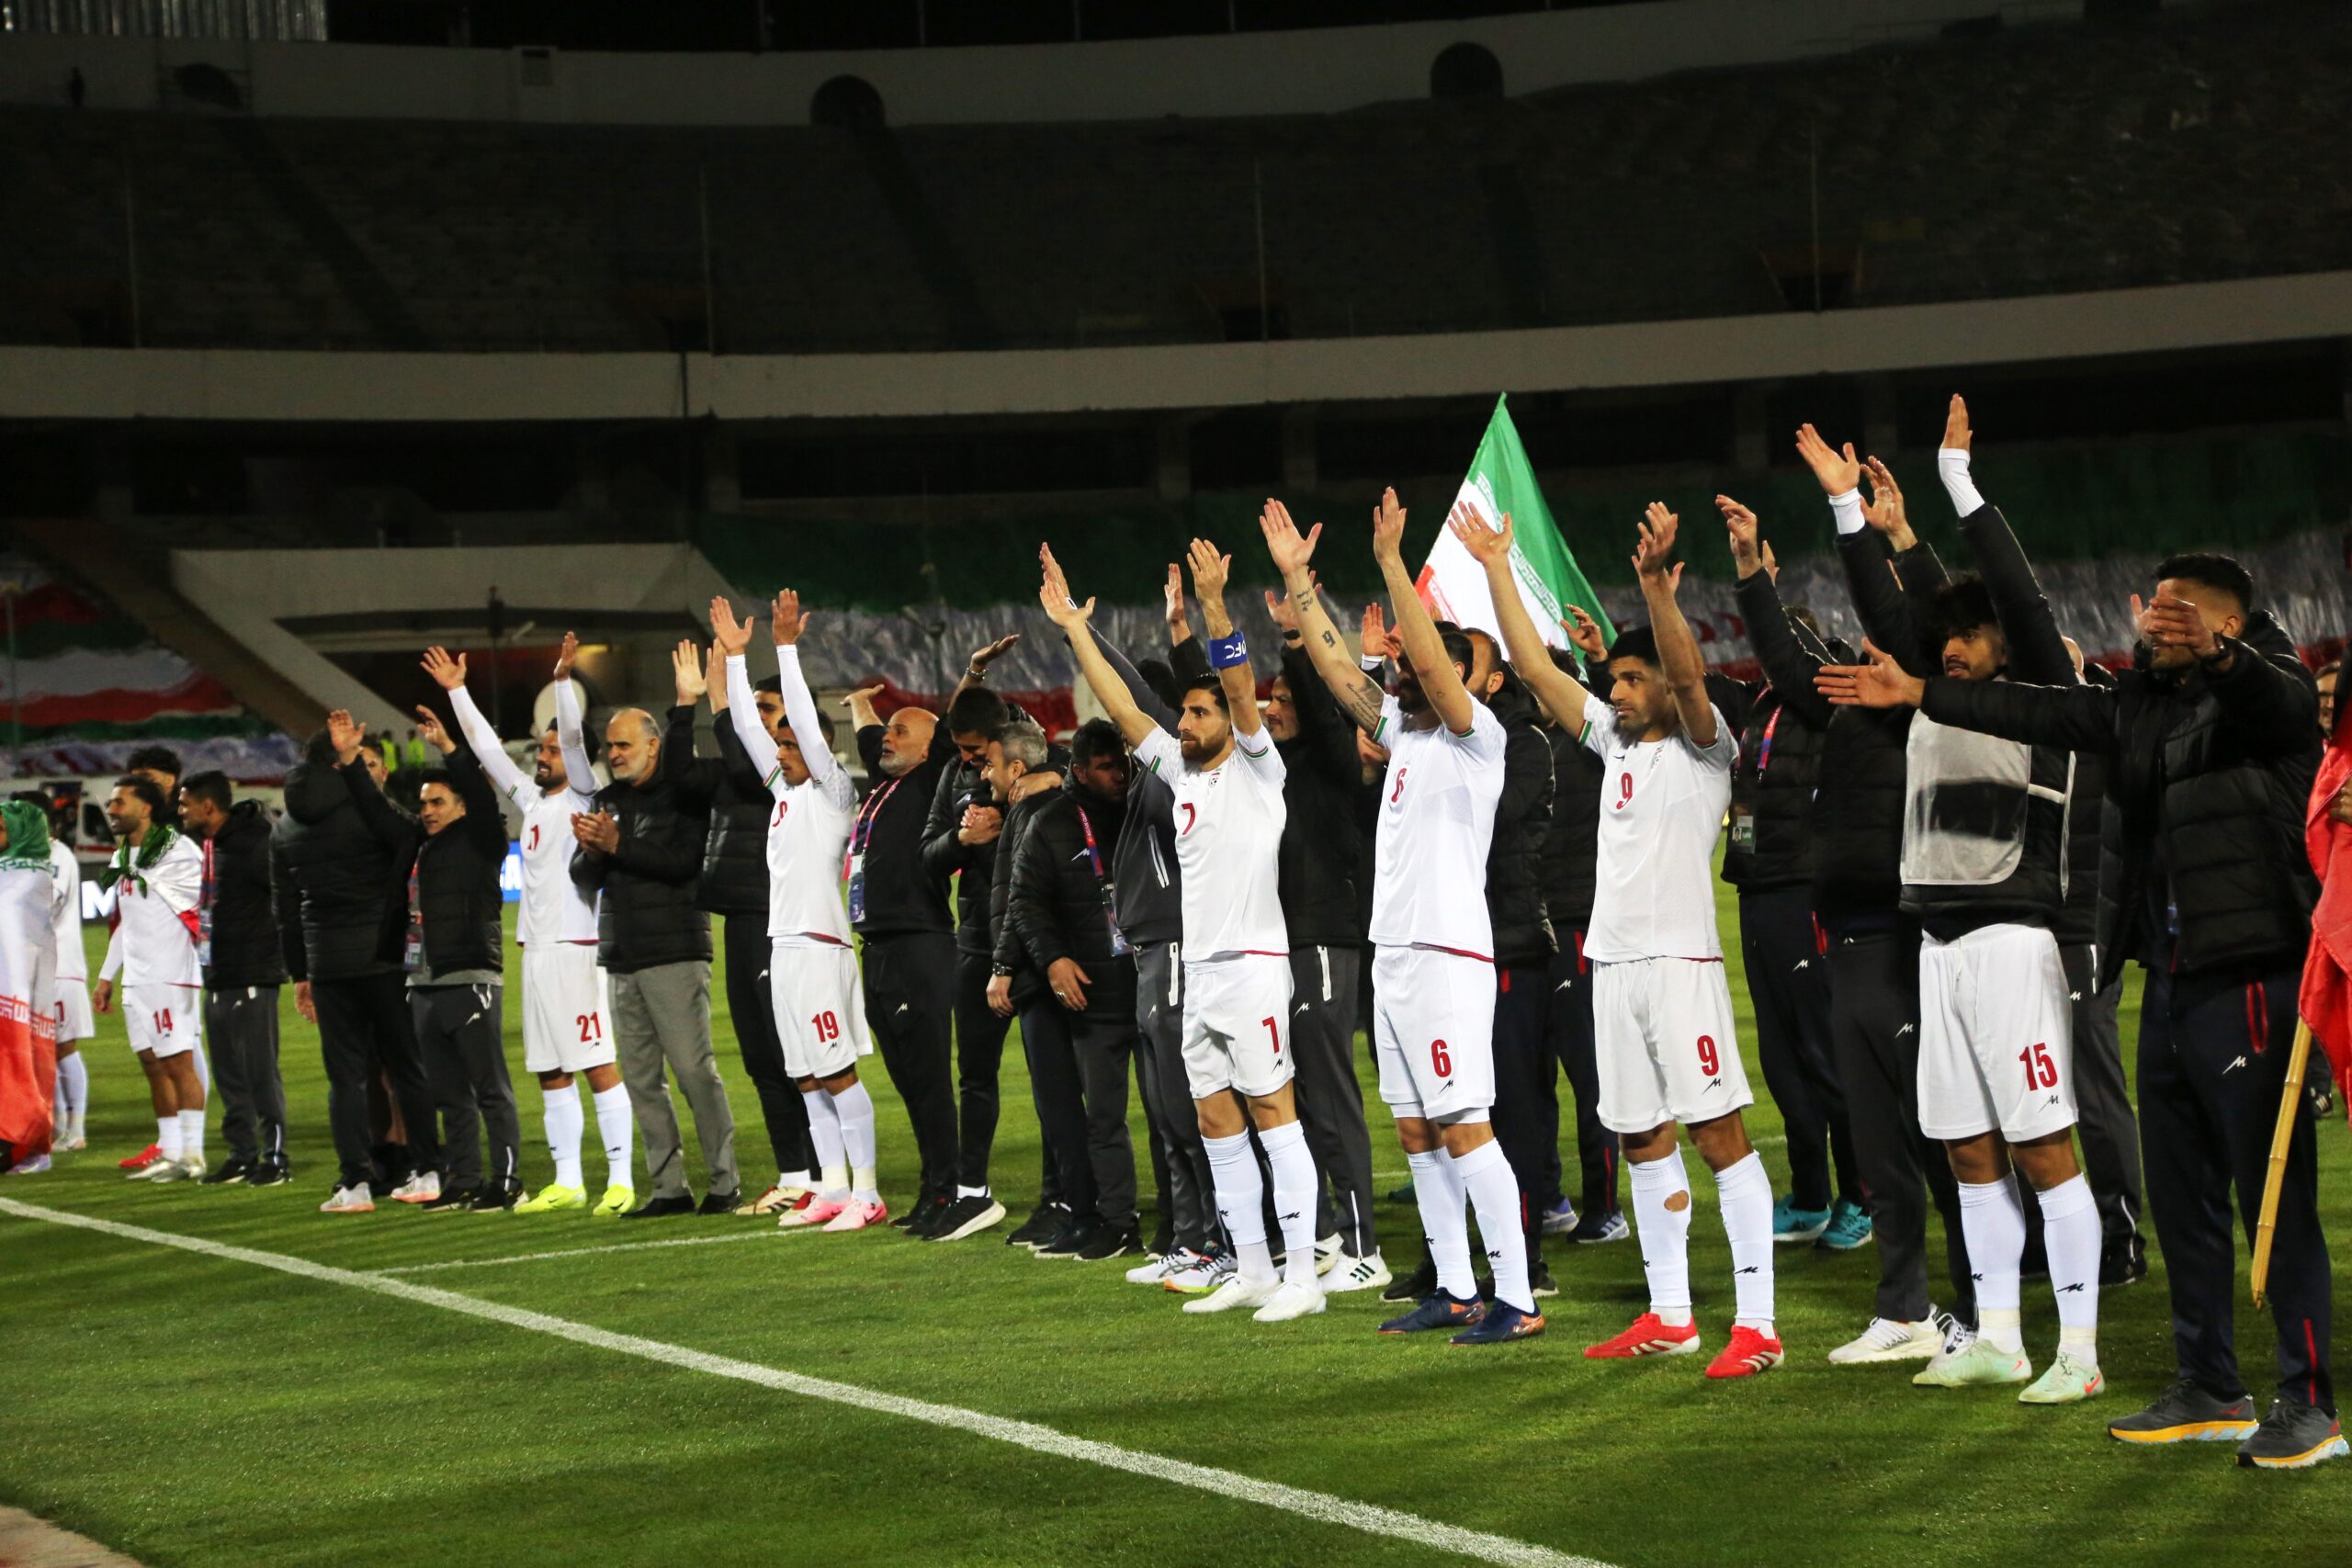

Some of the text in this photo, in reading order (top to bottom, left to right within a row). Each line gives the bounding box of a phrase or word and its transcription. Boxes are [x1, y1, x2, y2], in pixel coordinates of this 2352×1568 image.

[1391, 768, 1407, 804] 6
[1616, 773, 1634, 810] 9
[1182, 802, 1196, 836] 7
[153, 1008, 174, 1034] 14
[576, 1011, 602, 1043] 21
[811, 1010, 840, 1043] 19
[1430, 1038, 1453, 1078] 6
[1696, 1034, 1721, 1077] 9
[2018, 1042, 2058, 1091] 15
